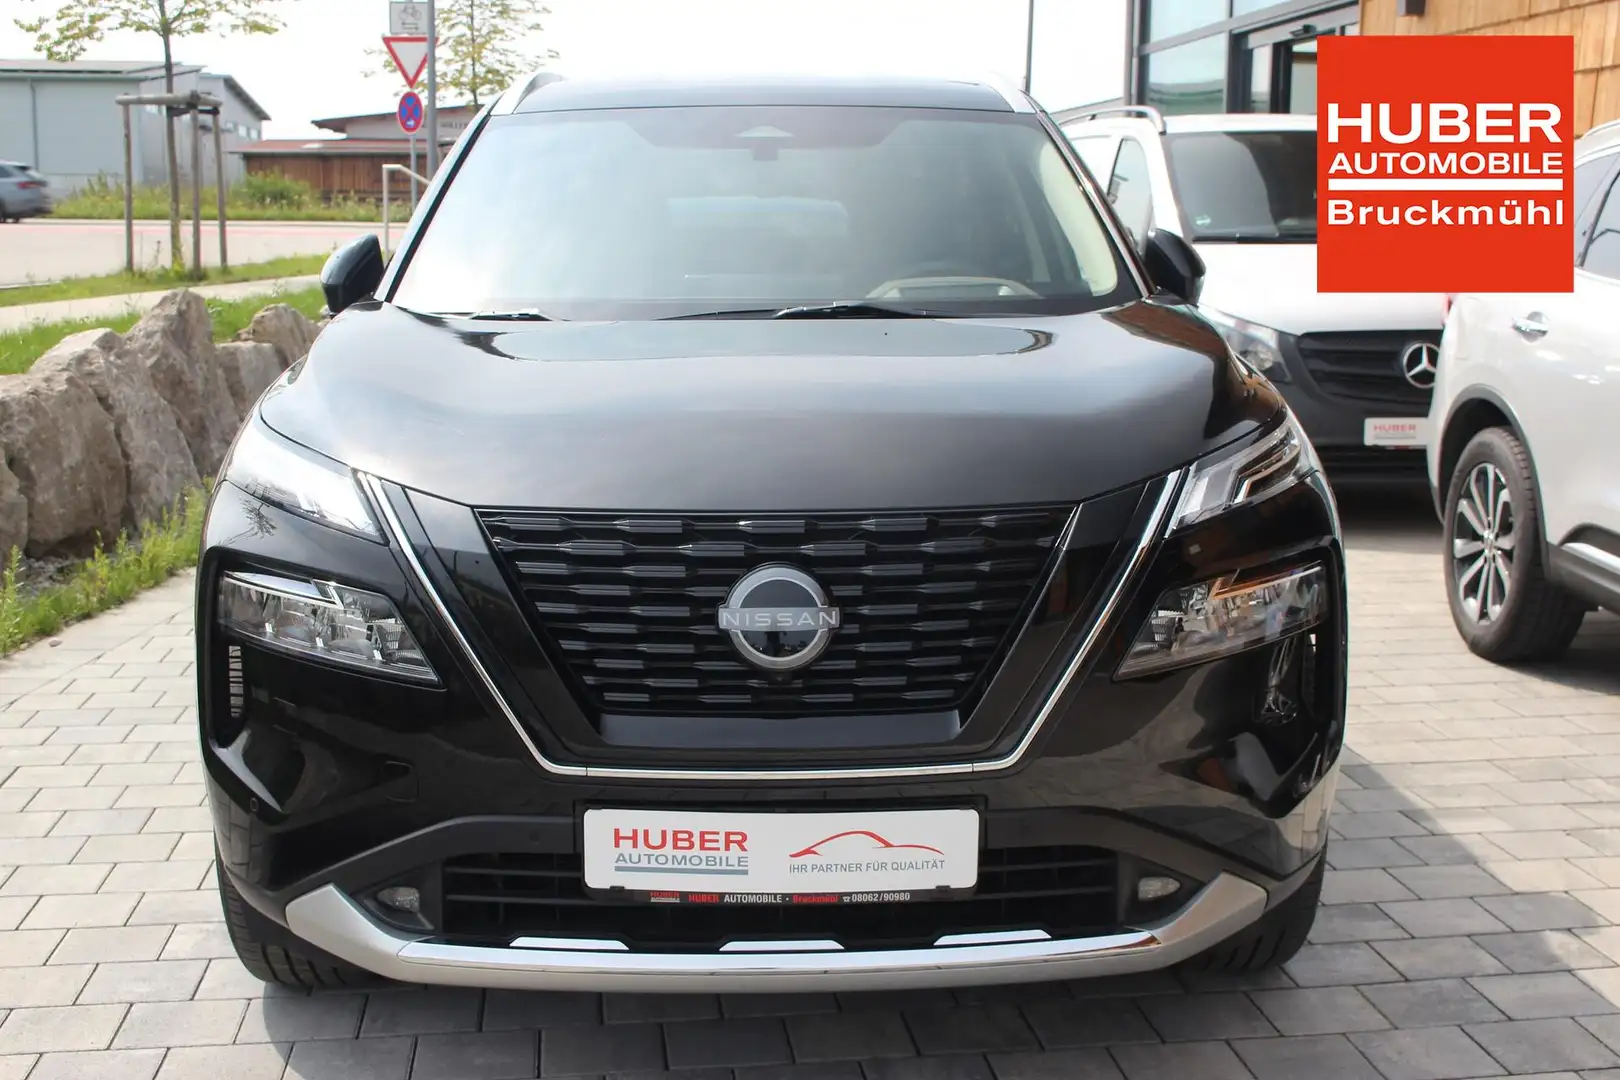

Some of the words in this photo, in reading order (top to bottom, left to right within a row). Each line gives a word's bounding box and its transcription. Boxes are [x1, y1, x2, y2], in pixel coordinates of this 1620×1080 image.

[722, 610, 837, 627] NISSAN
[613, 827, 749, 852] HUBER
[614, 852, 749, 868] AUTOMOBILE
[788, 863, 808, 874] IHR
[811, 861, 863, 873] PARTNER
[865, 860, 888, 872] FÜR
[891, 858, 945, 871] QUALITÄT
[687, 893, 720, 904] HUBER
[723, 893, 783, 904] AUTOMOBILE
[851, 892, 911, 903] 08062/90980
